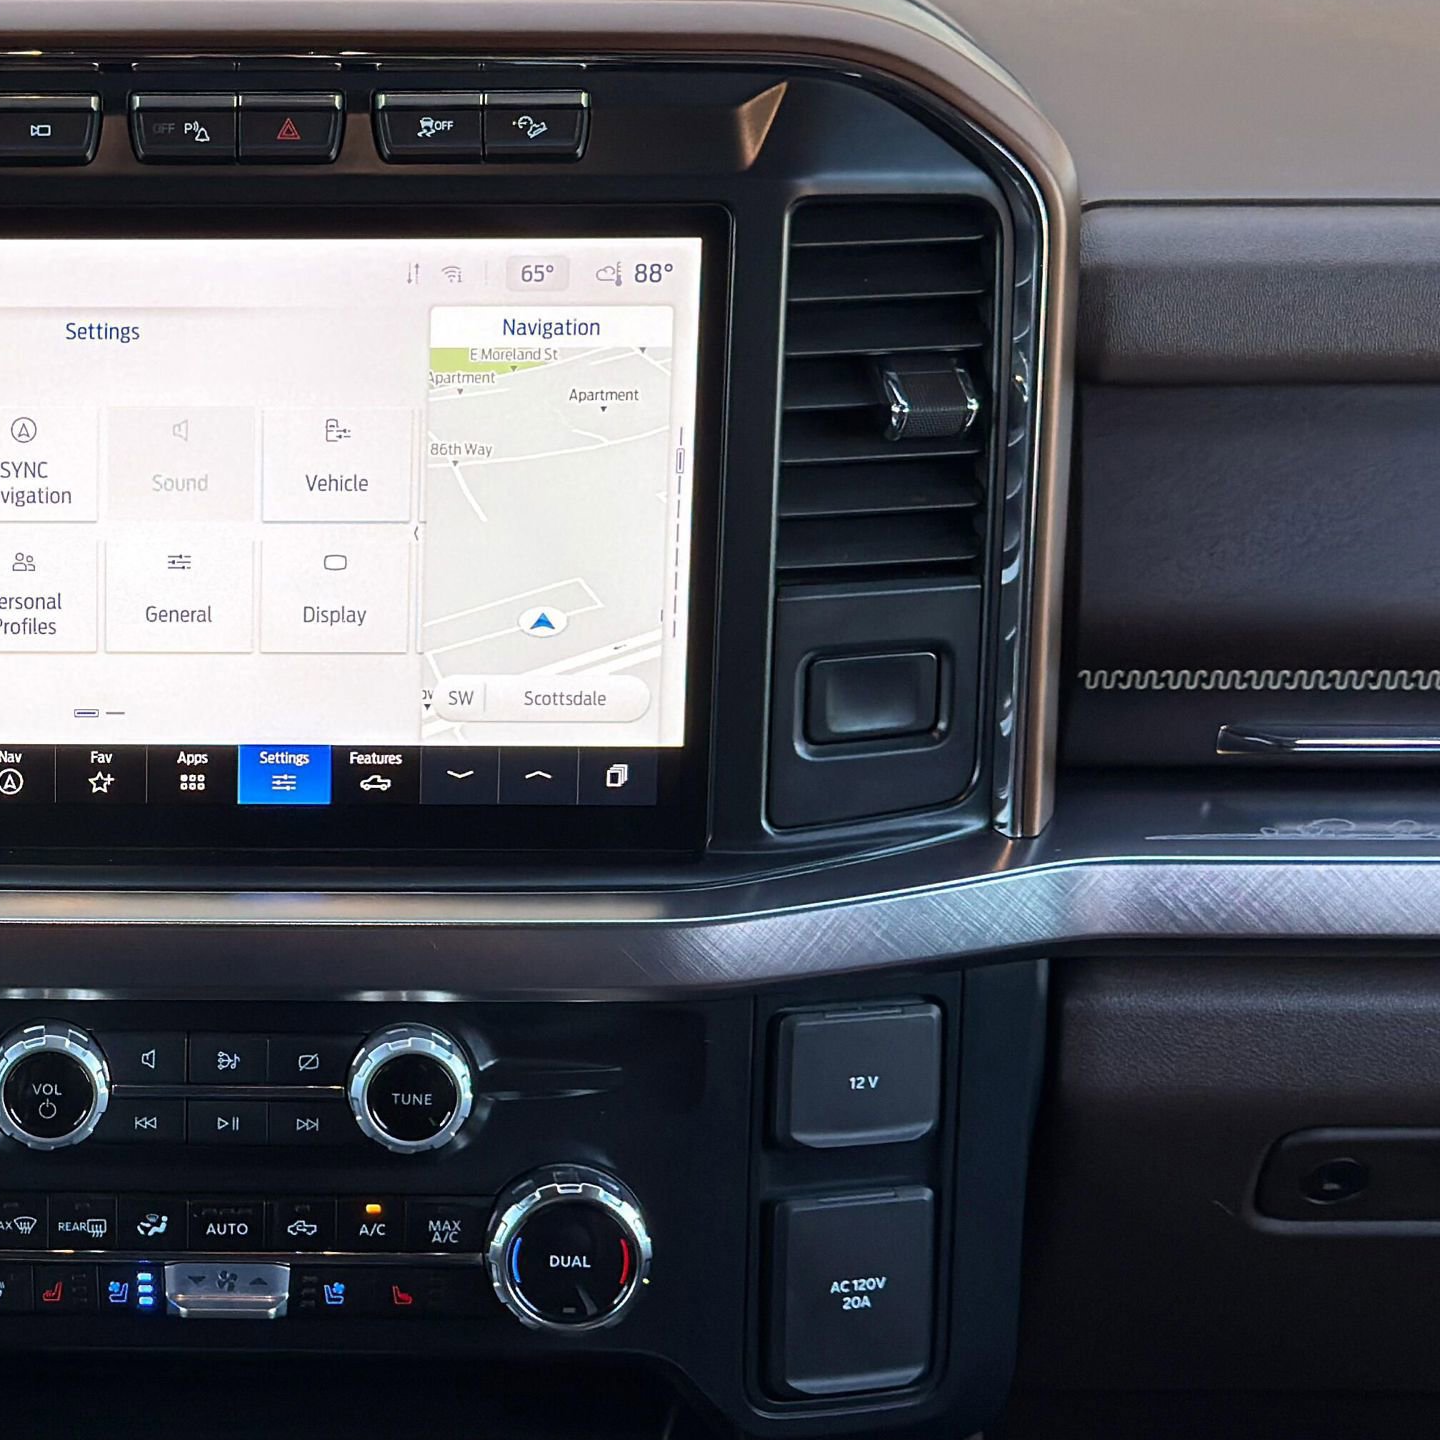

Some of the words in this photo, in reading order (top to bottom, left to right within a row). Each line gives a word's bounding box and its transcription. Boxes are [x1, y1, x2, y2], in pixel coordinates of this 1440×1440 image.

[435, 121, 453, 130] OFF
[522, 265, 553, 282] 65°
[635, 264, 673, 283] 88°
[66, 323, 139, 343] Settings
[503, 319, 599, 339] Navigation
[471, 348, 477, 360] E
[482, 348, 540, 360] Moreland
[545, 348, 557, 360] St
[429, 372, 494, 385] Apartment
[569, 389, 638, 402] Apartment
[431, 443, 461, 455] 86th
[465, 444, 492, 457] Way
[0, 462, 47, 478] SYNC
[152, 474, 208, 492] Sound
[306, 474, 368, 491] Vehicle
[146, 606, 212, 622] General
[304, 606, 366, 626] Display
[449, 691, 473, 705] SW
[525, 691, 606, 705] Scottsdale
[0, 751, 22, 763] Nav
[91, 751, 112, 763] Fav
[177, 751, 208, 765] Apps
[260, 751, 309, 766] Settings
[350, 752, 402, 764] Features
[33, 1084, 61, 1095] VOL
[392, 1094, 432, 1105] TUNE
[59, 1222, 86, 1231] REAR
[206, 1223, 248, 1235] AUTO
[360, 1224, 385, 1236] A/C
[429, 1220, 460, 1231] MAX
[432, 1231, 458, 1243] A/C
[550, 1255, 590, 1267] DUAL
[831, 1281, 849, 1293] AC
[852, 1277, 886, 1291] 120V
[843, 1296, 870, 1309] 20A
